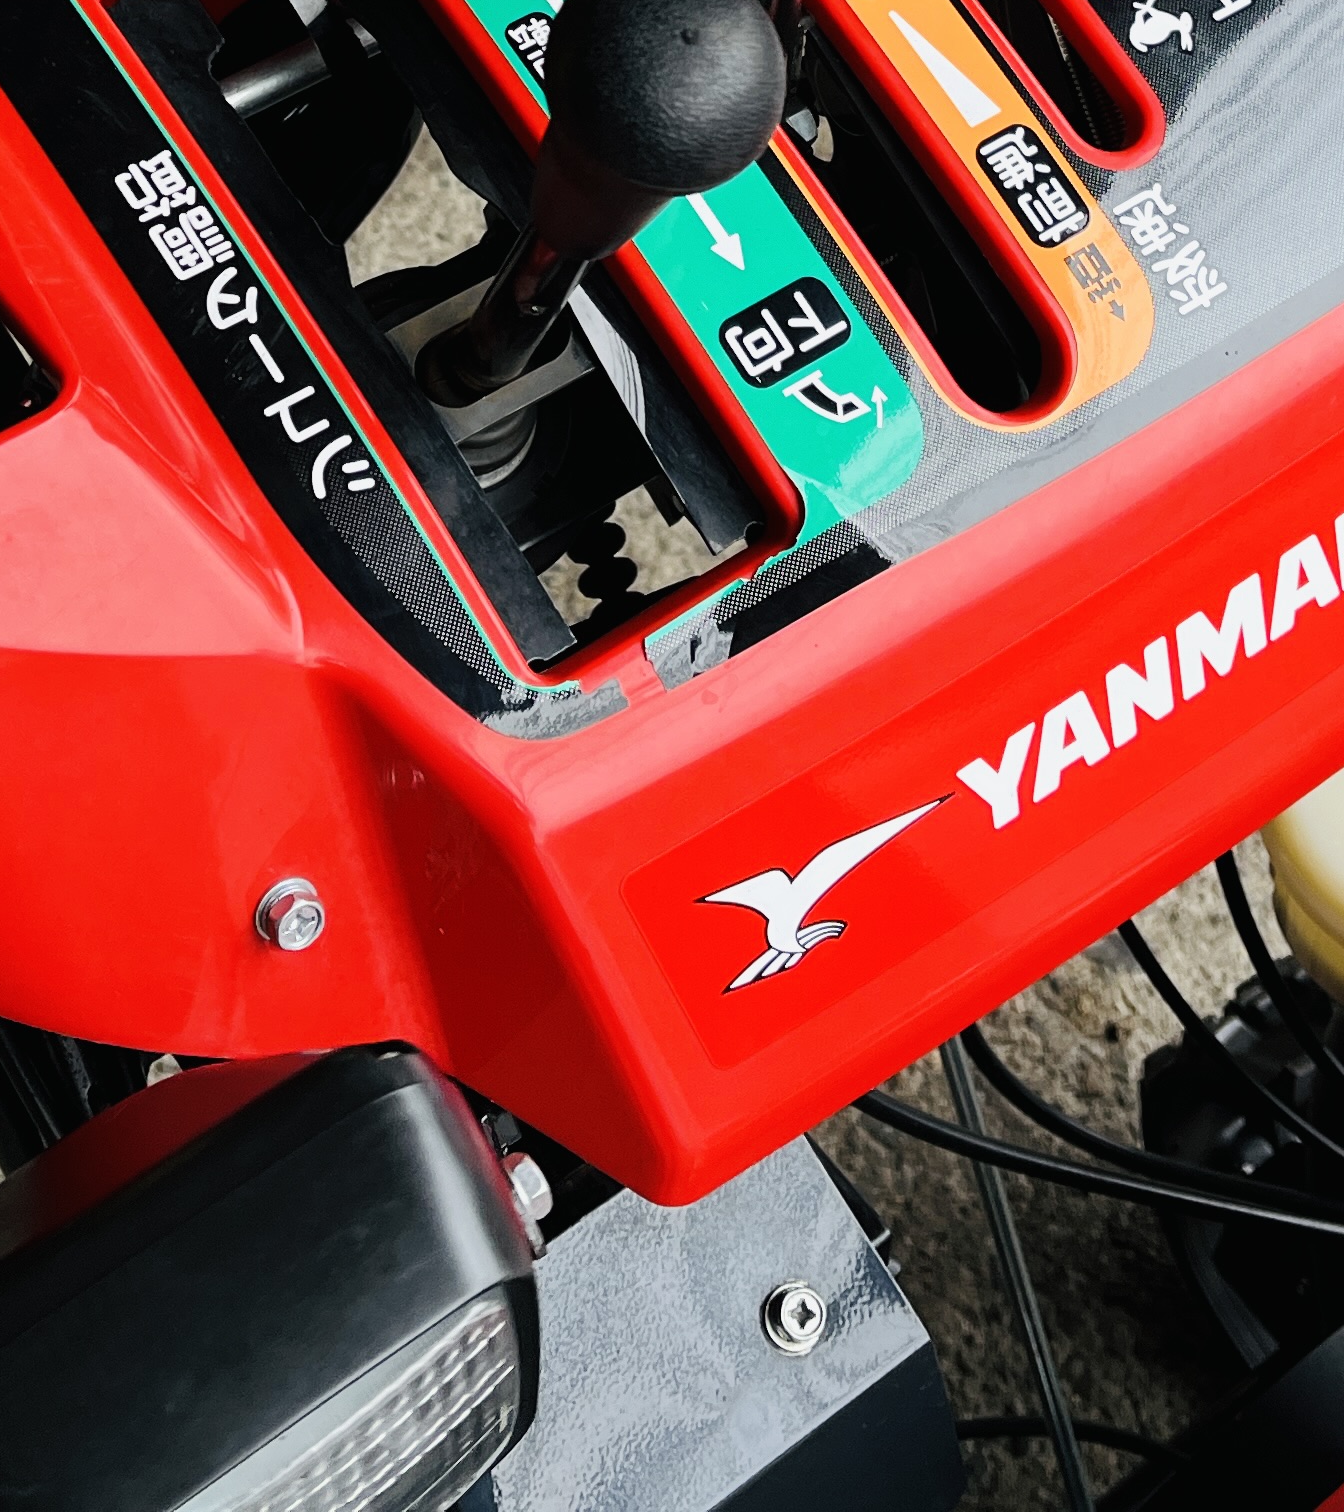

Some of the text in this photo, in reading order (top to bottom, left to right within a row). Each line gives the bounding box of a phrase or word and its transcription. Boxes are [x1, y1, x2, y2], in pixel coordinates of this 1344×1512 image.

[980, 127, 1087, 243] 前進
[1113, 183, 1227, 314] 変速
[115, 150, 375, 499] シュータ調節
[725, 292, 847, 376] 下向
